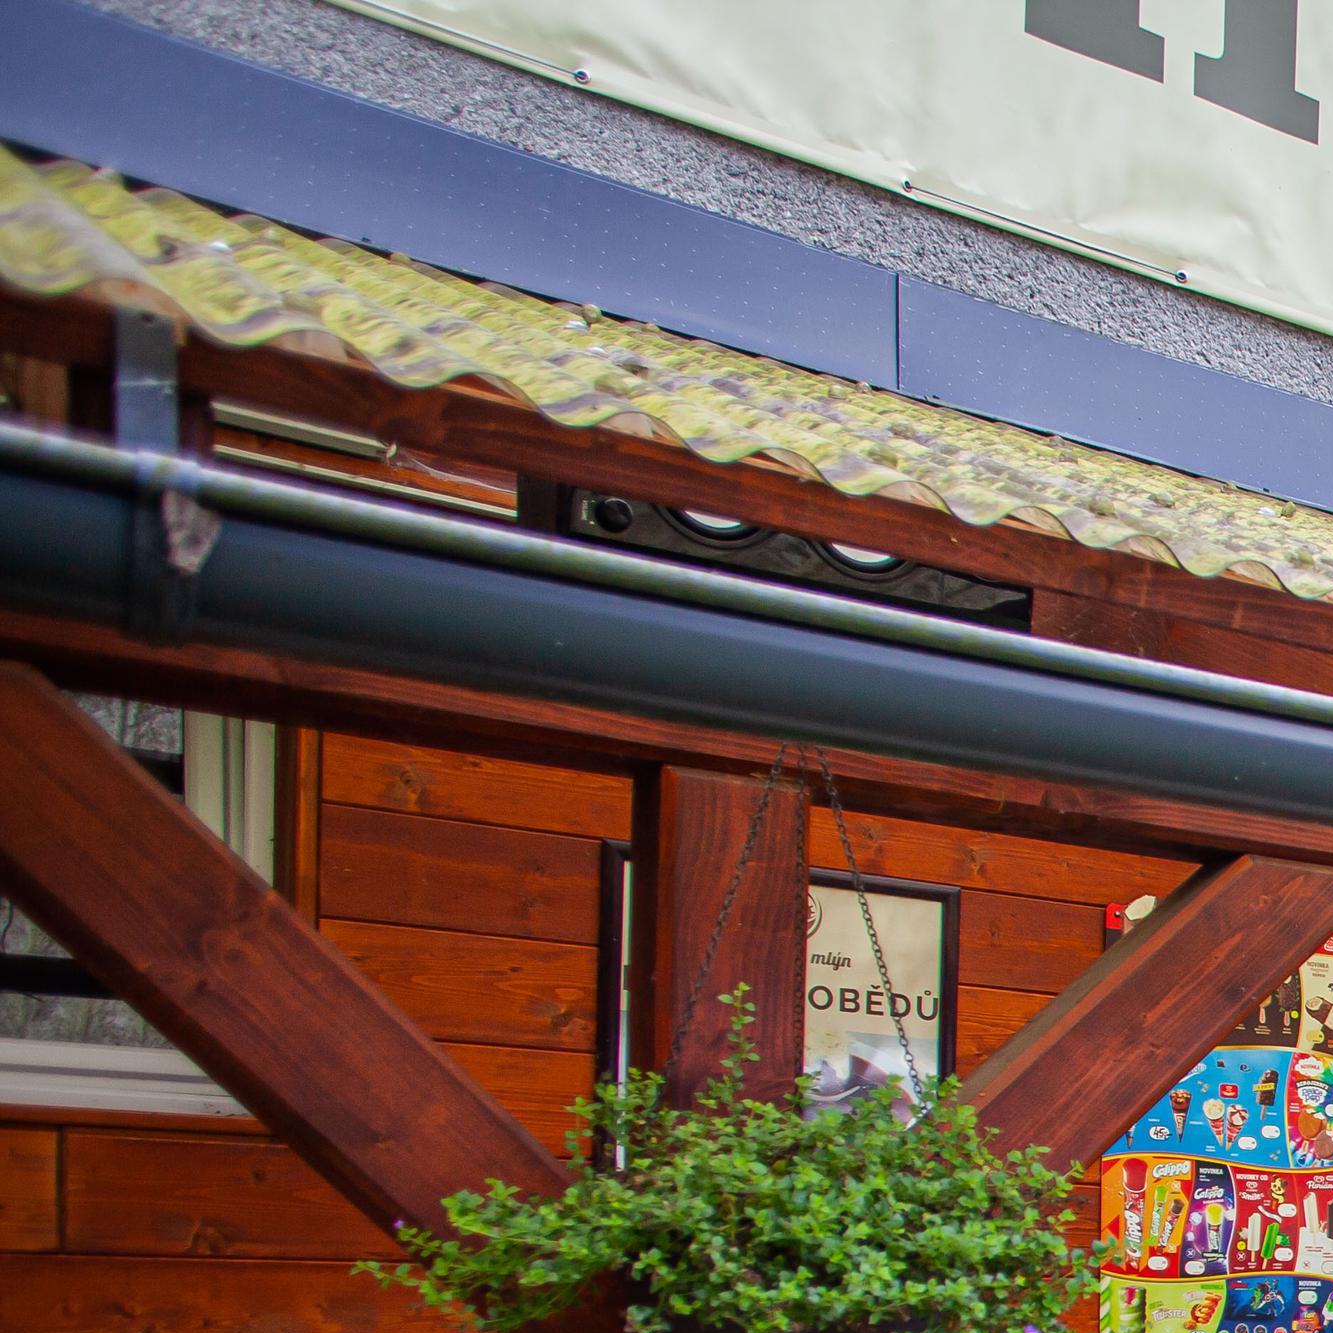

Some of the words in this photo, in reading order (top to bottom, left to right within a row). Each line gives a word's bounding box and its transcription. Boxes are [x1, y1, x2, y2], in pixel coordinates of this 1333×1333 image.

[810, 951, 851, 972] mlýn
[807, 984, 940, 1021] OBĚDŮ
[1152, 1160, 1191, 1178] Calippo
[1194, 1187, 1224, 1200] Calippo
